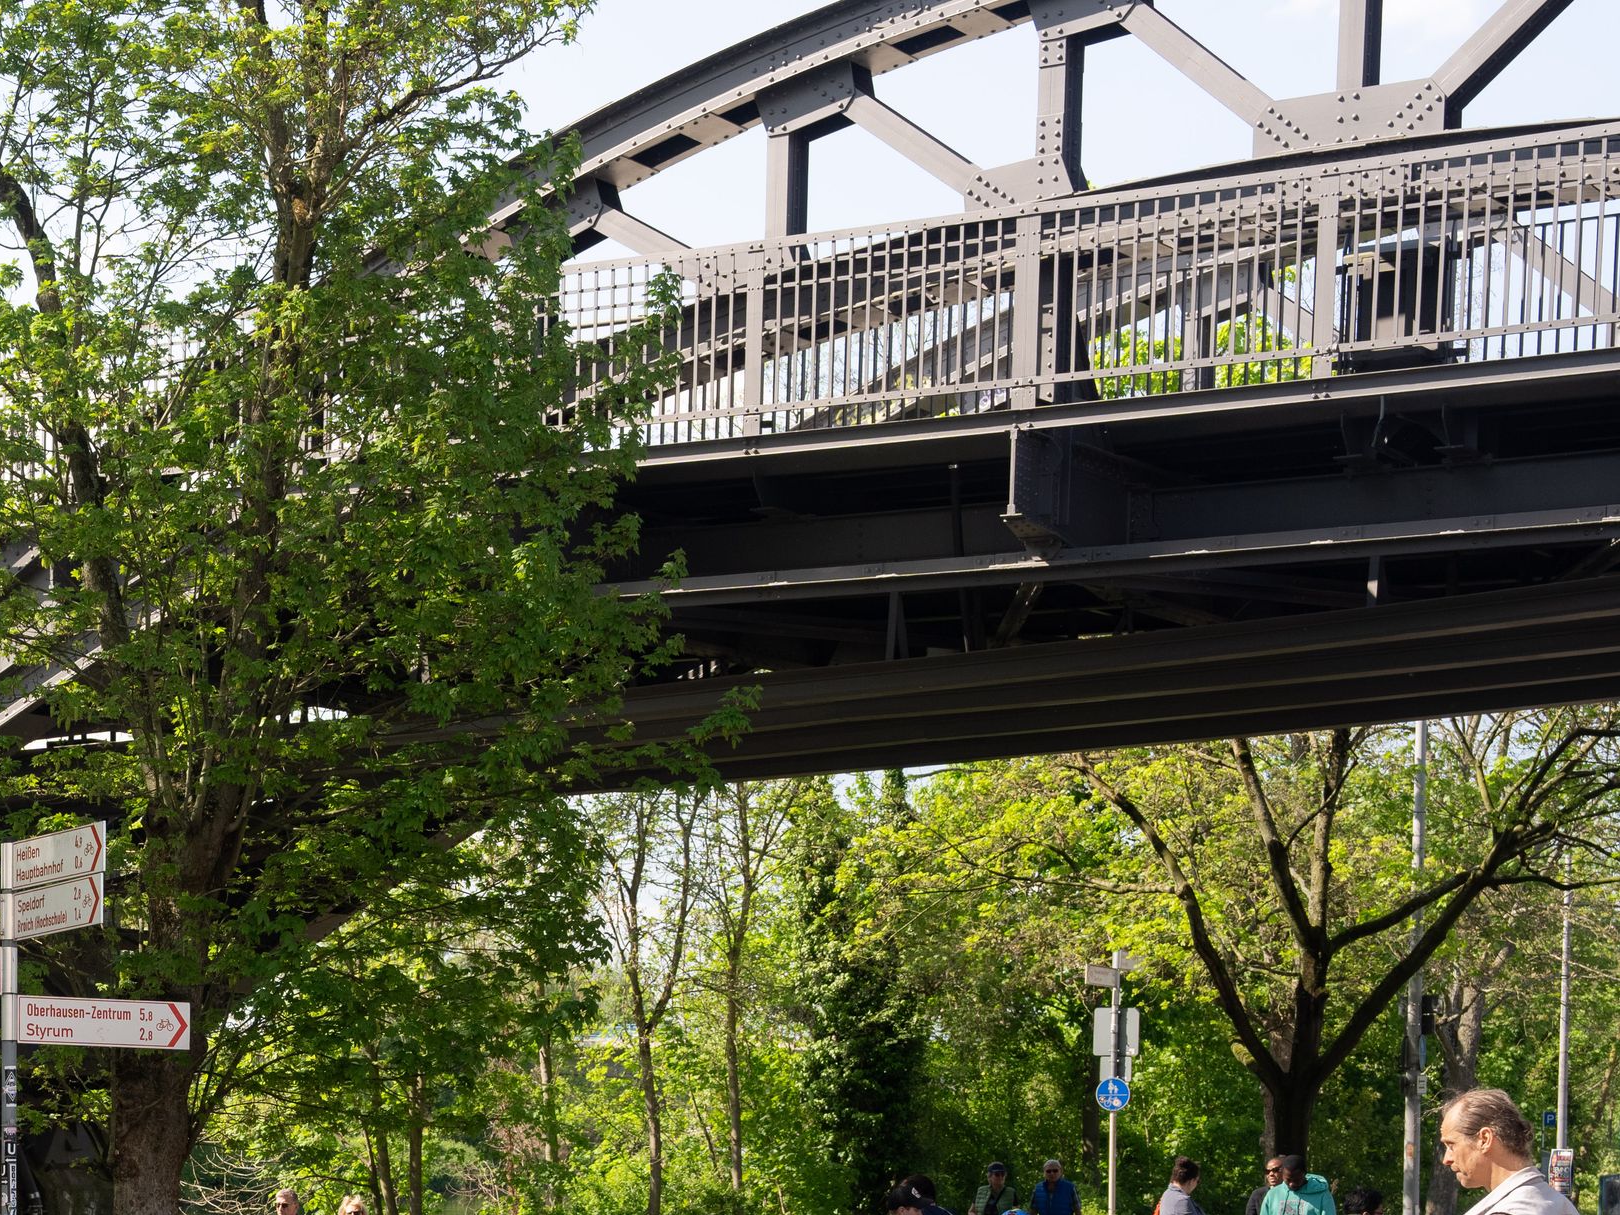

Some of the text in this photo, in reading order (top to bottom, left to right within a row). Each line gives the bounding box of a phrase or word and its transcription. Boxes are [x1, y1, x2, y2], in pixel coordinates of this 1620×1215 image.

[16, 845, 40, 862] Heißen
[16, 859, 64, 882] Hauptbahnhof
[17, 894, 45, 914] Speldorf
[27, 1003, 132, 1021] Oberhausen-Zentrum
[26, 1023, 74, 1040] Styrum
